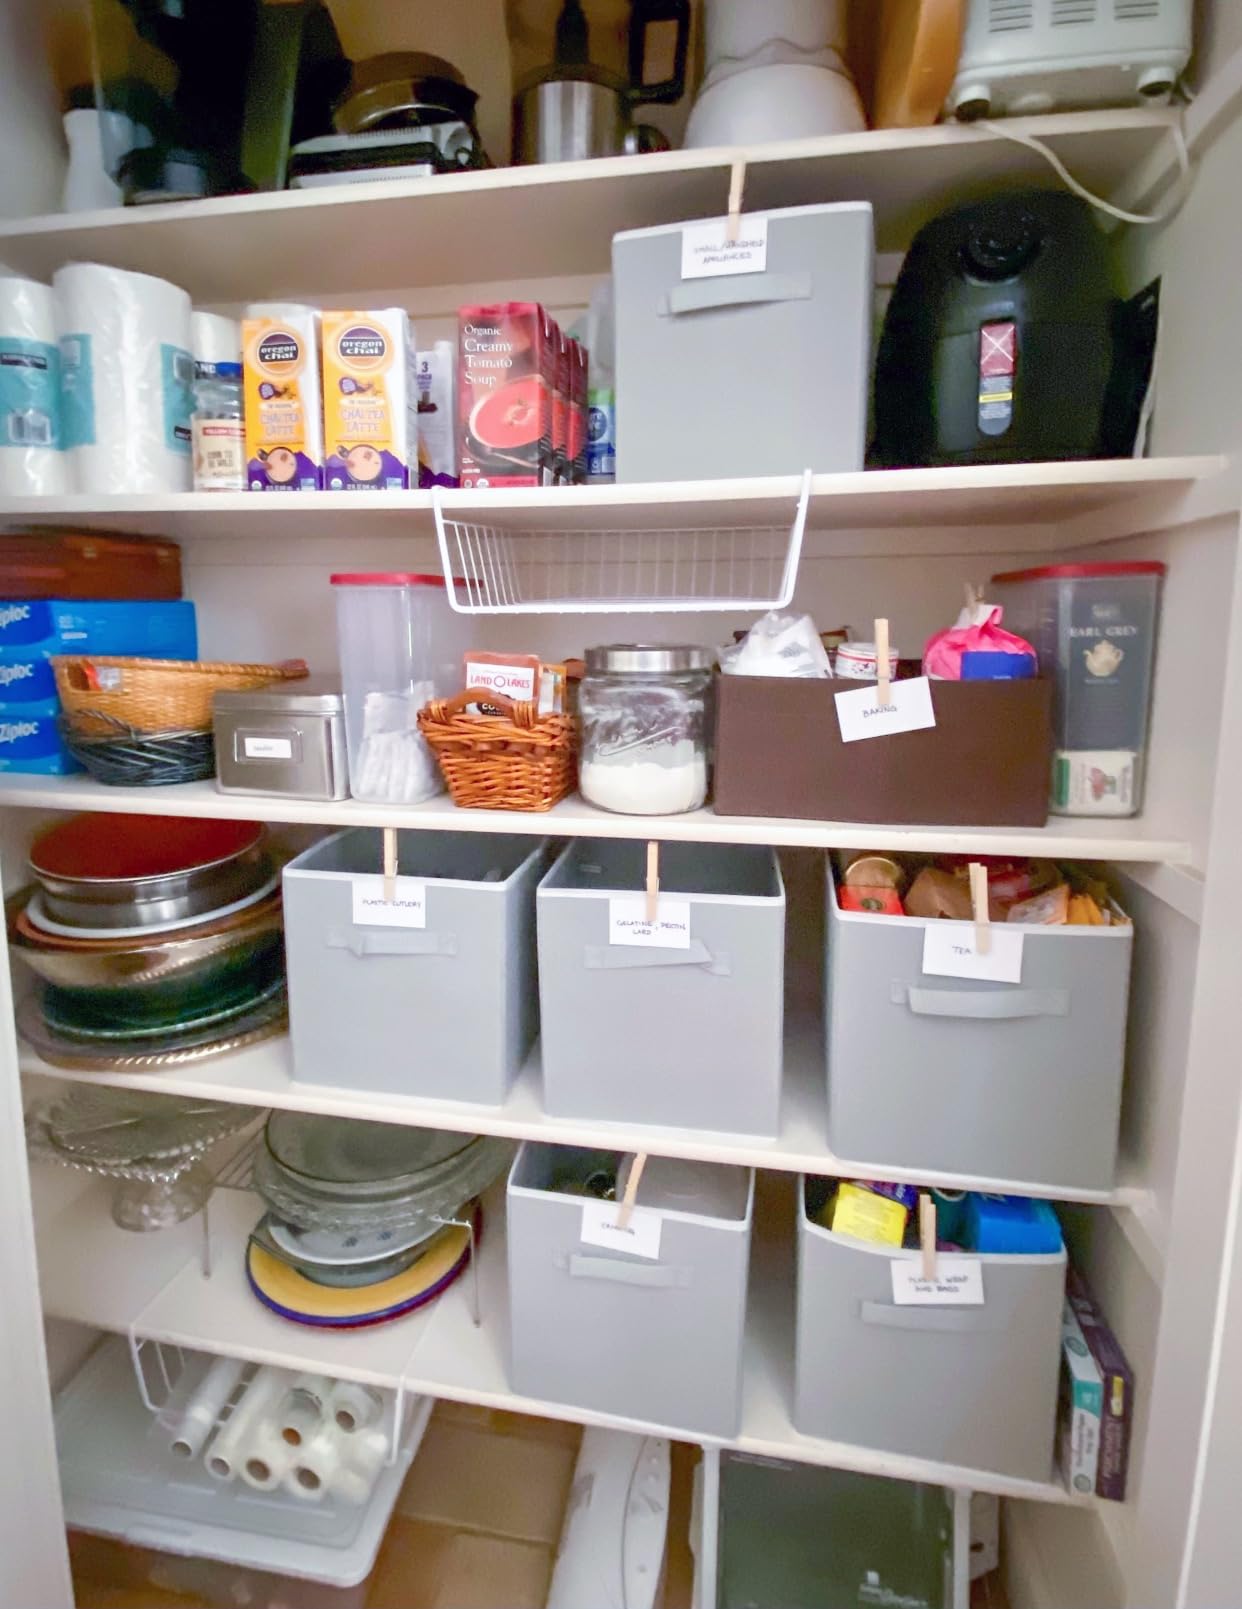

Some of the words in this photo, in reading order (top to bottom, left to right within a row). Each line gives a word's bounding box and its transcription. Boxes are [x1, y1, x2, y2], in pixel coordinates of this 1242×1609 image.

[464, 324, 502, 336] Organic
[261, 345, 297, 354] oregon
[342, 341, 383, 349] oregon
[464, 339, 513, 353] Creamy
[264, 352, 294, 360] chai
[464, 354, 513, 368] Tomato
[421, 361, 429, 373] 3
[464, 371, 497, 388] Soup
[342, 409, 366, 420] CHAI
[367, 410, 385, 420] TEA
[346, 422, 381, 432] LATTE
[0, 605, 31, 629] iploc
[1069, 628, 1100, 638] EARL
[1105, 625, 1138, 637] GREY
[470, 675, 493, 686] LAND
[507, 678, 530, 689] LAKES
[862, 705, 898, 718] BAKING
[0, 721, 39, 743] Ziploc
[392, 900, 421, 909] CUTLERY
[952, 945, 973, 954] TEA
